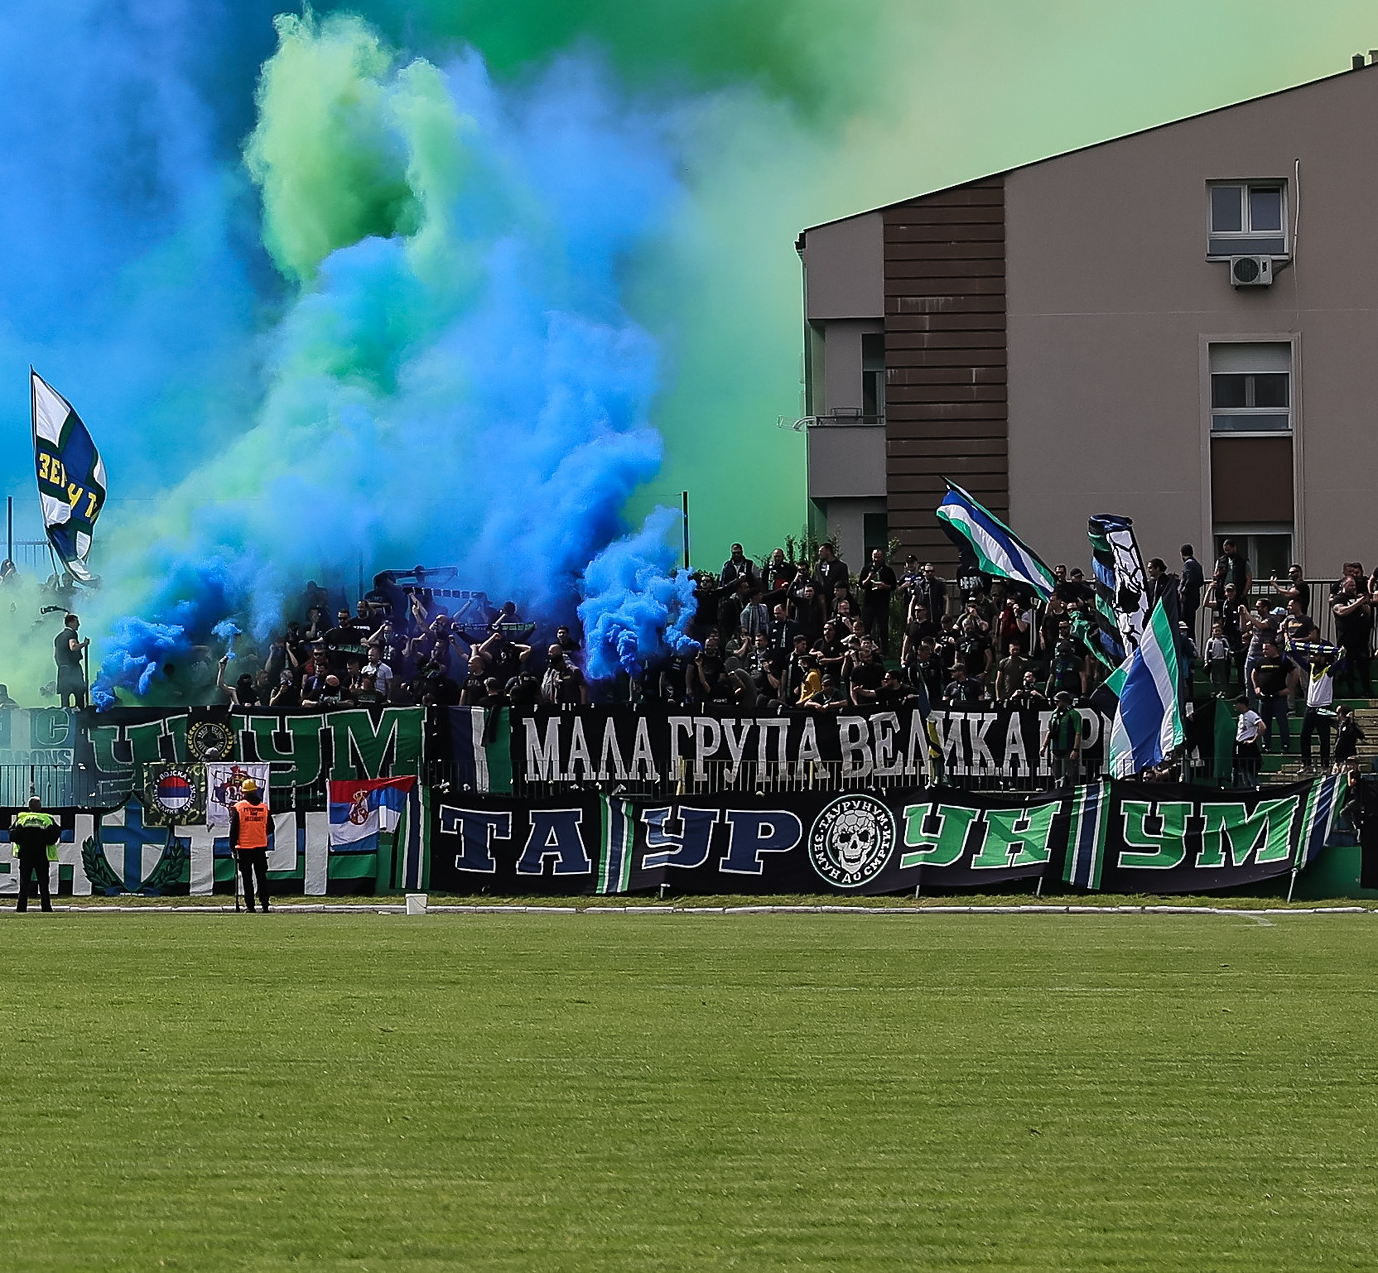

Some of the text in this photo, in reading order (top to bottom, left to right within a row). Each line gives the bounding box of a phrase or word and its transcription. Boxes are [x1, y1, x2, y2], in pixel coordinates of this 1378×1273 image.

[522, 715, 660, 783] МАЛА
[667, 715, 832, 784] ГРУПА
[818, 800, 889, 830] ТАУРУНУМ
[813, 834, 841, 880] ЗЕМУН
[863, 829, 892, 876] СМРТИ
